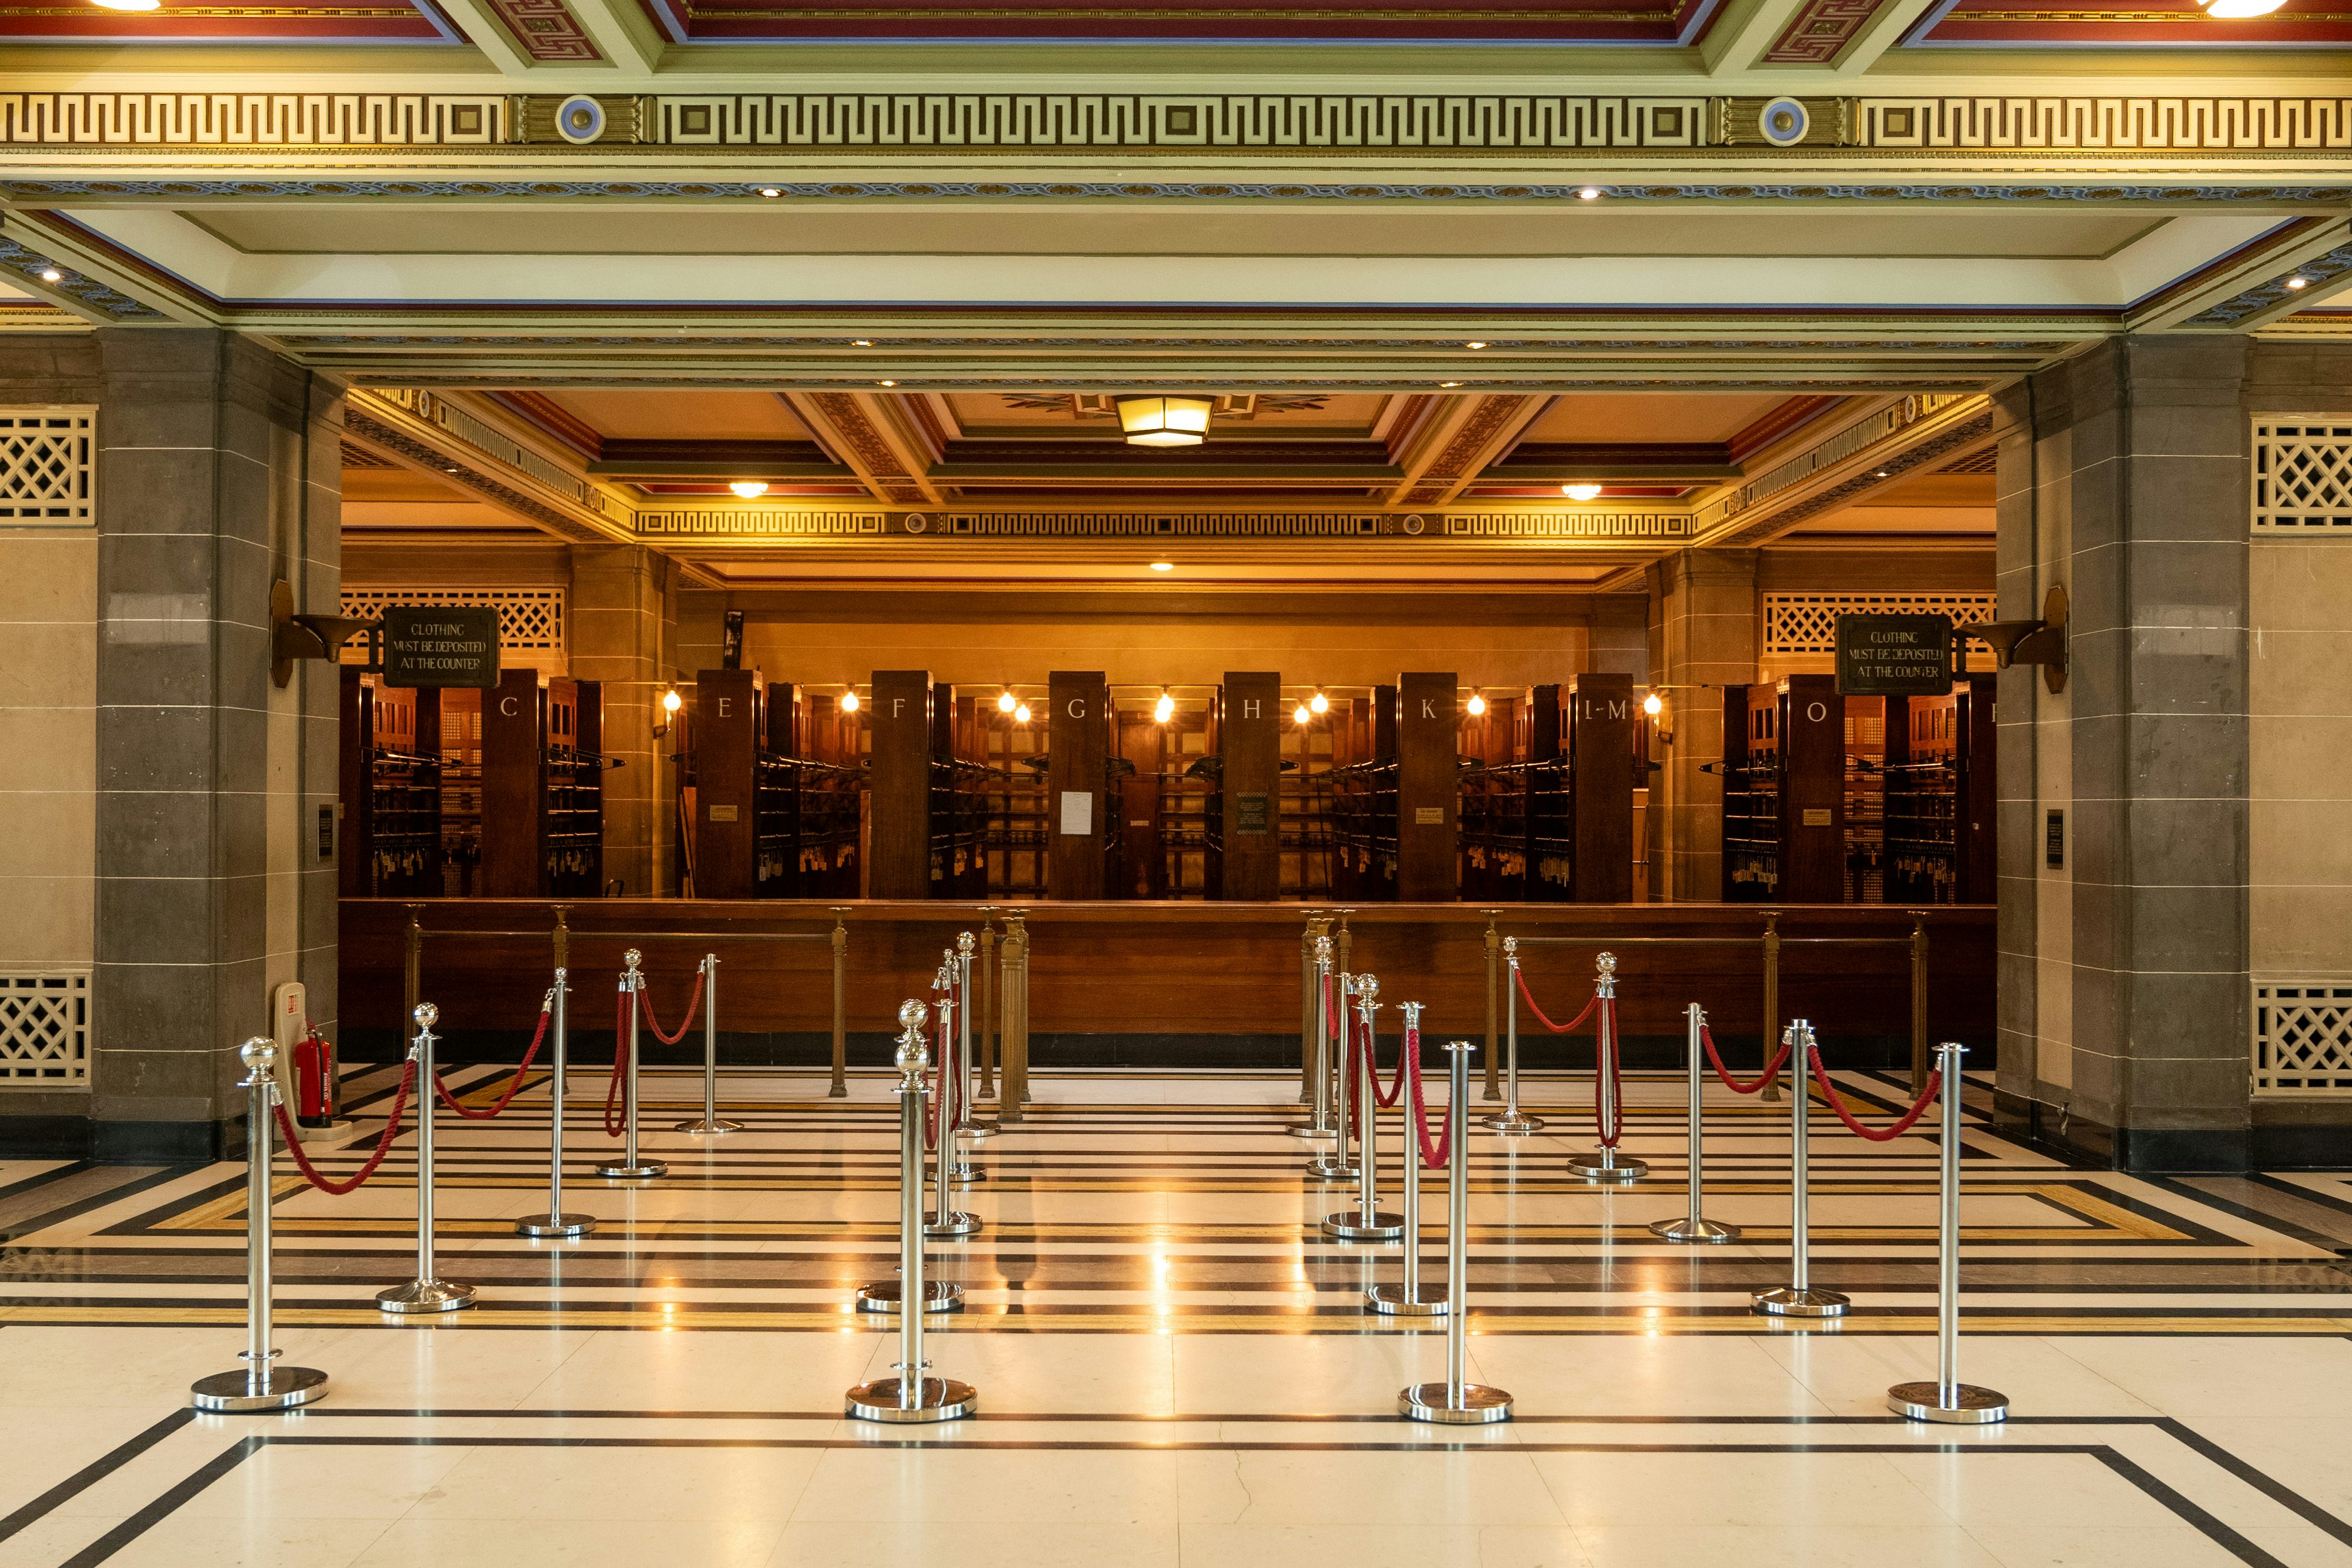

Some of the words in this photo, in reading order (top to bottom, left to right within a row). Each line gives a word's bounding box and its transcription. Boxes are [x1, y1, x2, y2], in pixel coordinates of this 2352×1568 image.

[411, 624, 465, 636] CLOTHING
[1870, 631, 1918, 643] CLOTHING
[393, 641, 419, 652] MUST
[422, 641, 435, 652] BE
[436, 641, 486, 653] DEPOSITED
[1849, 648, 1875, 660] MUST
[1877, 648, 1890, 660] BE
[1892, 649, 1943, 660] DEPOSITED
[400, 657, 415, 668] AT
[417, 657, 436, 669] THE
[437, 658, 480, 670] COUNTER
[1858, 666, 1872, 677] AT
[1875, 666, 1894, 677] THE
[1895, 666, 1939, 678] COUNTER
[500, 697, 517, 716] C
[719, 698, 731, 717] E
[893, 698, 906, 718] F
[1068, 699, 1085, 718] G
[1244, 700, 1261, 718] H
[1422, 699, 1436, 718] K
[1807, 702, 1826, 722] O
